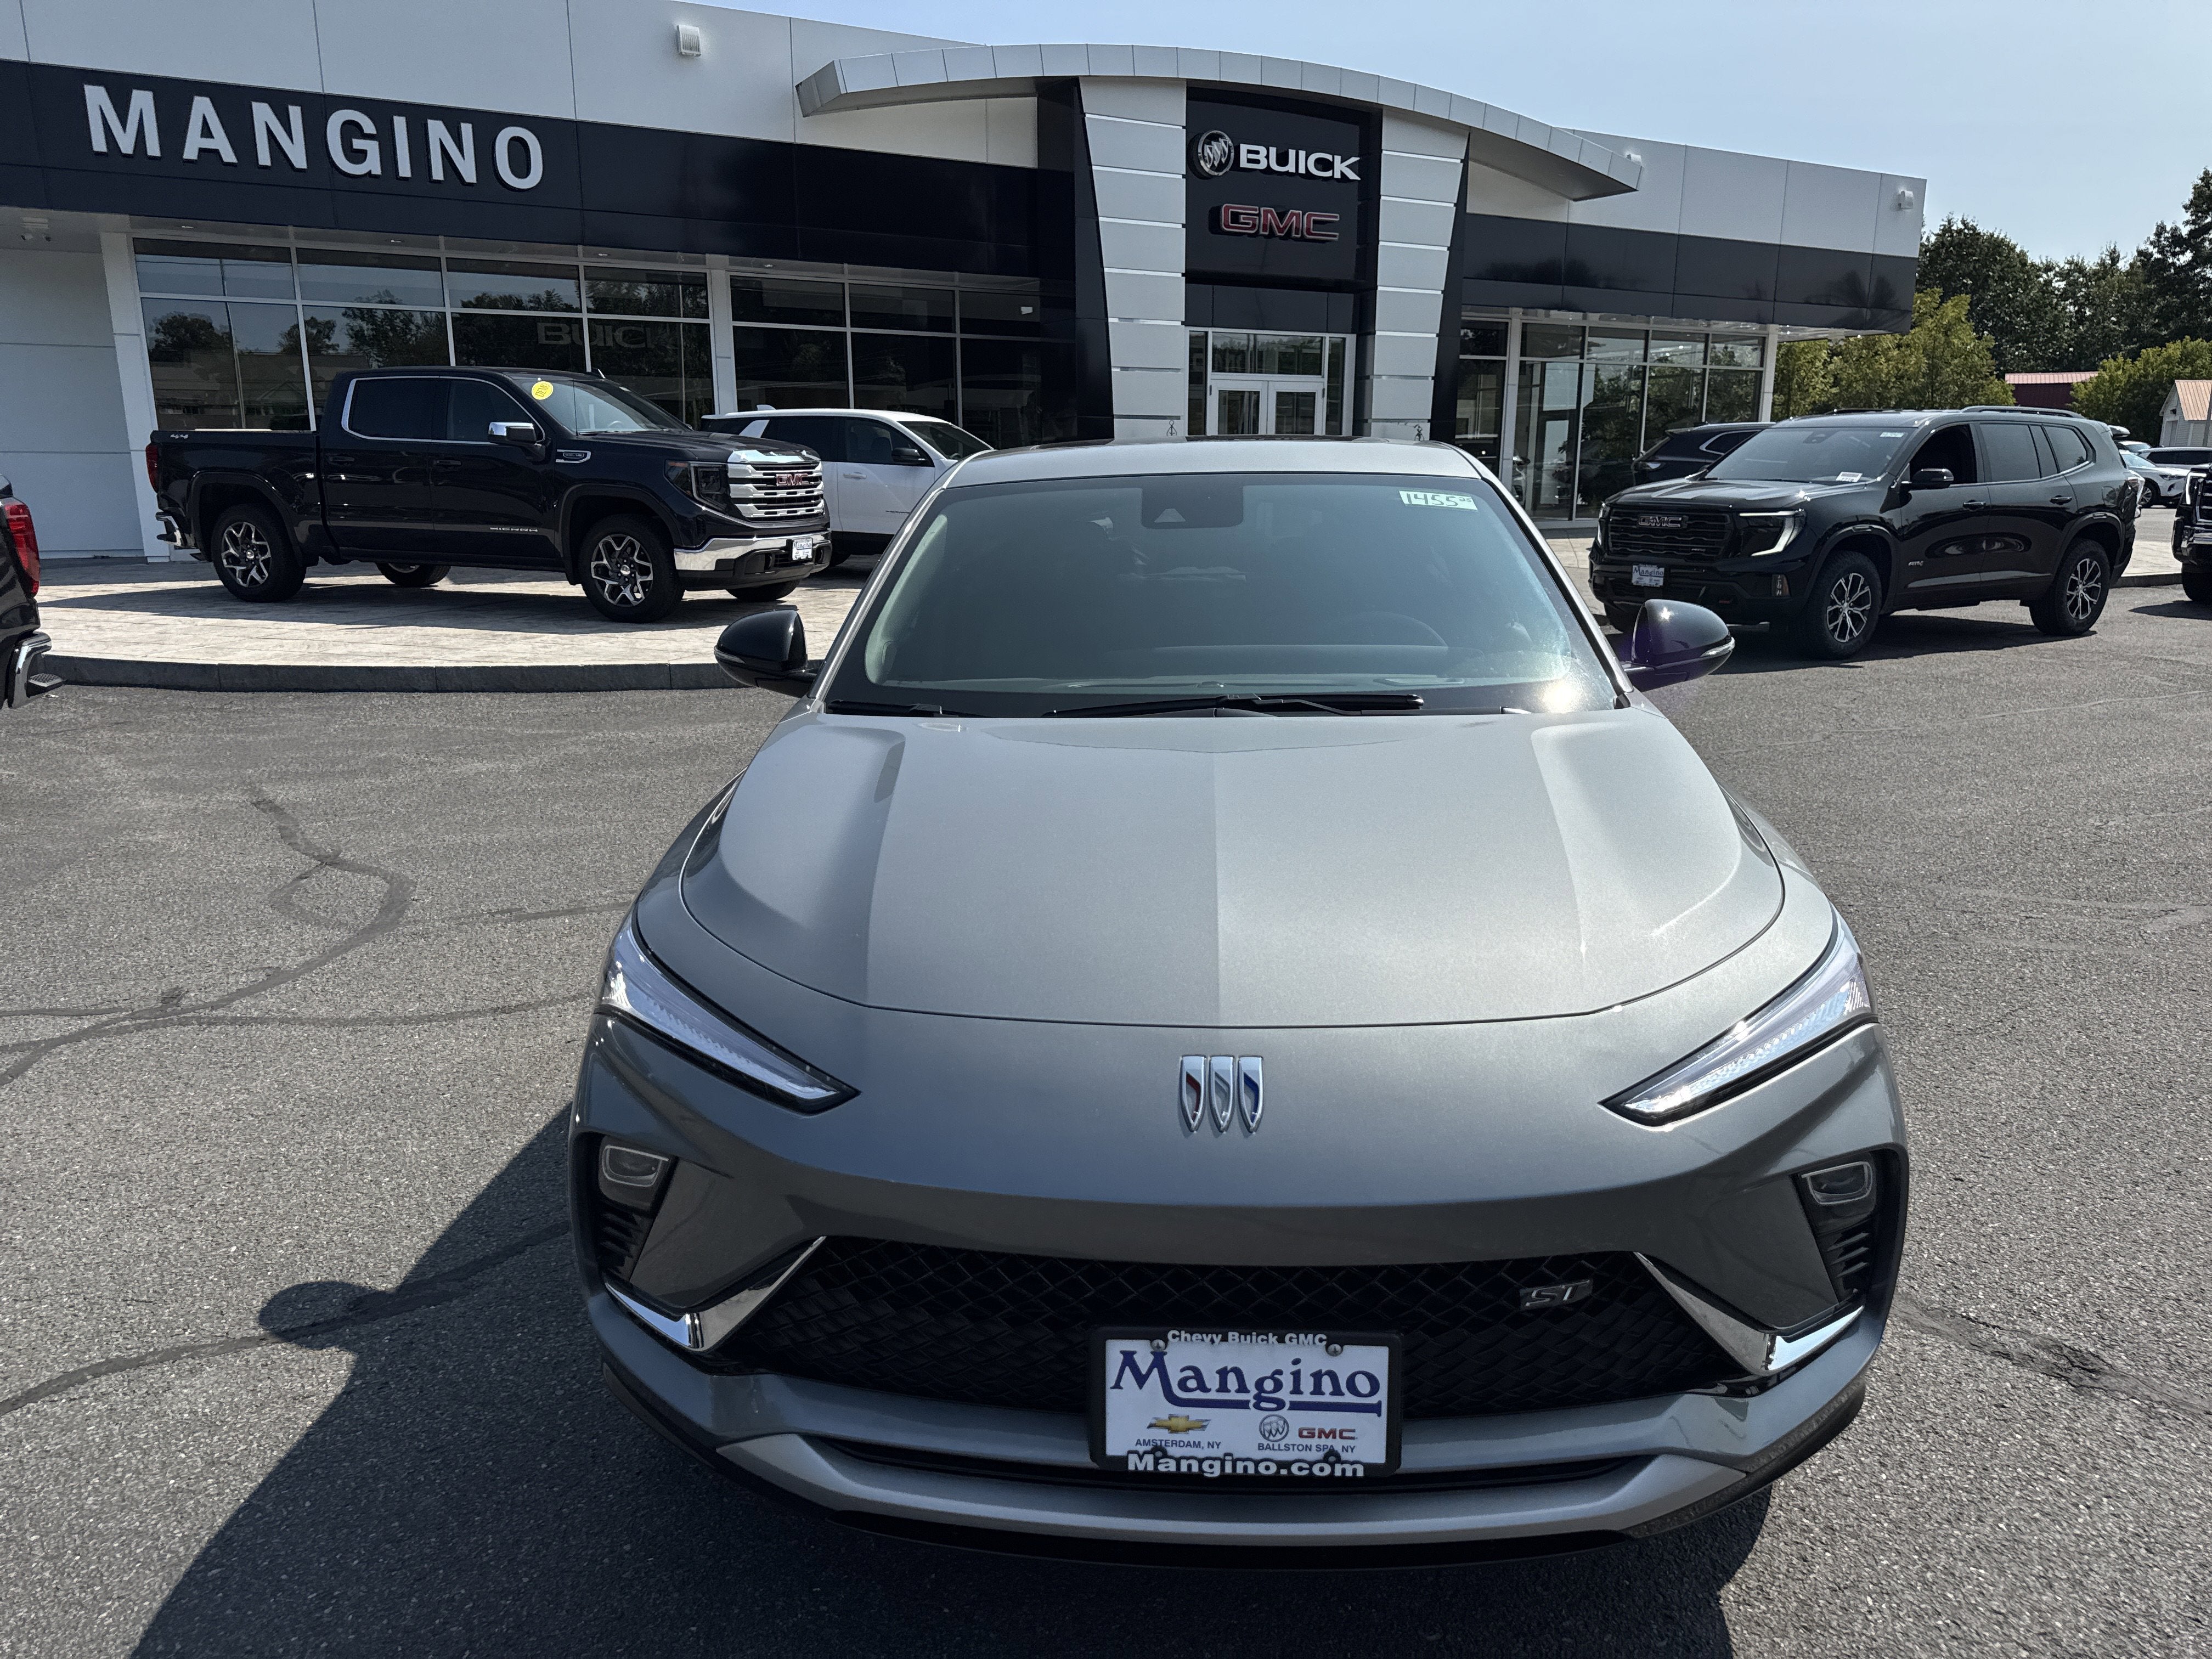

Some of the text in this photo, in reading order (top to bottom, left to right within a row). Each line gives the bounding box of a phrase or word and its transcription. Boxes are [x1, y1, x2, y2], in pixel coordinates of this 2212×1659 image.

[83, 84, 543, 190] MANGINO
[1239, 143, 1361, 180] BUICK
[1222, 204, 1340, 241] GMC
[776, 473, 809, 487] GMC
[1406, 493, 1458, 506] 1455
[1638, 516, 1682, 528] GMC
[1633, 565, 1664, 578] Mangino
[1167, 1330, 1328, 1345] Chevy Buick GMC
[1110, 1350, 1382, 1415] Mangino
[1297, 1427, 1358, 1440] GMC
[1135, 1438, 1222, 1450] AMSTERDAM, NY
[1257, 1443, 1312, 1452] BALLSTON
[1341, 1445, 1356, 1453] NY
[1127, 1453, 1364, 1477] Mangino.com
